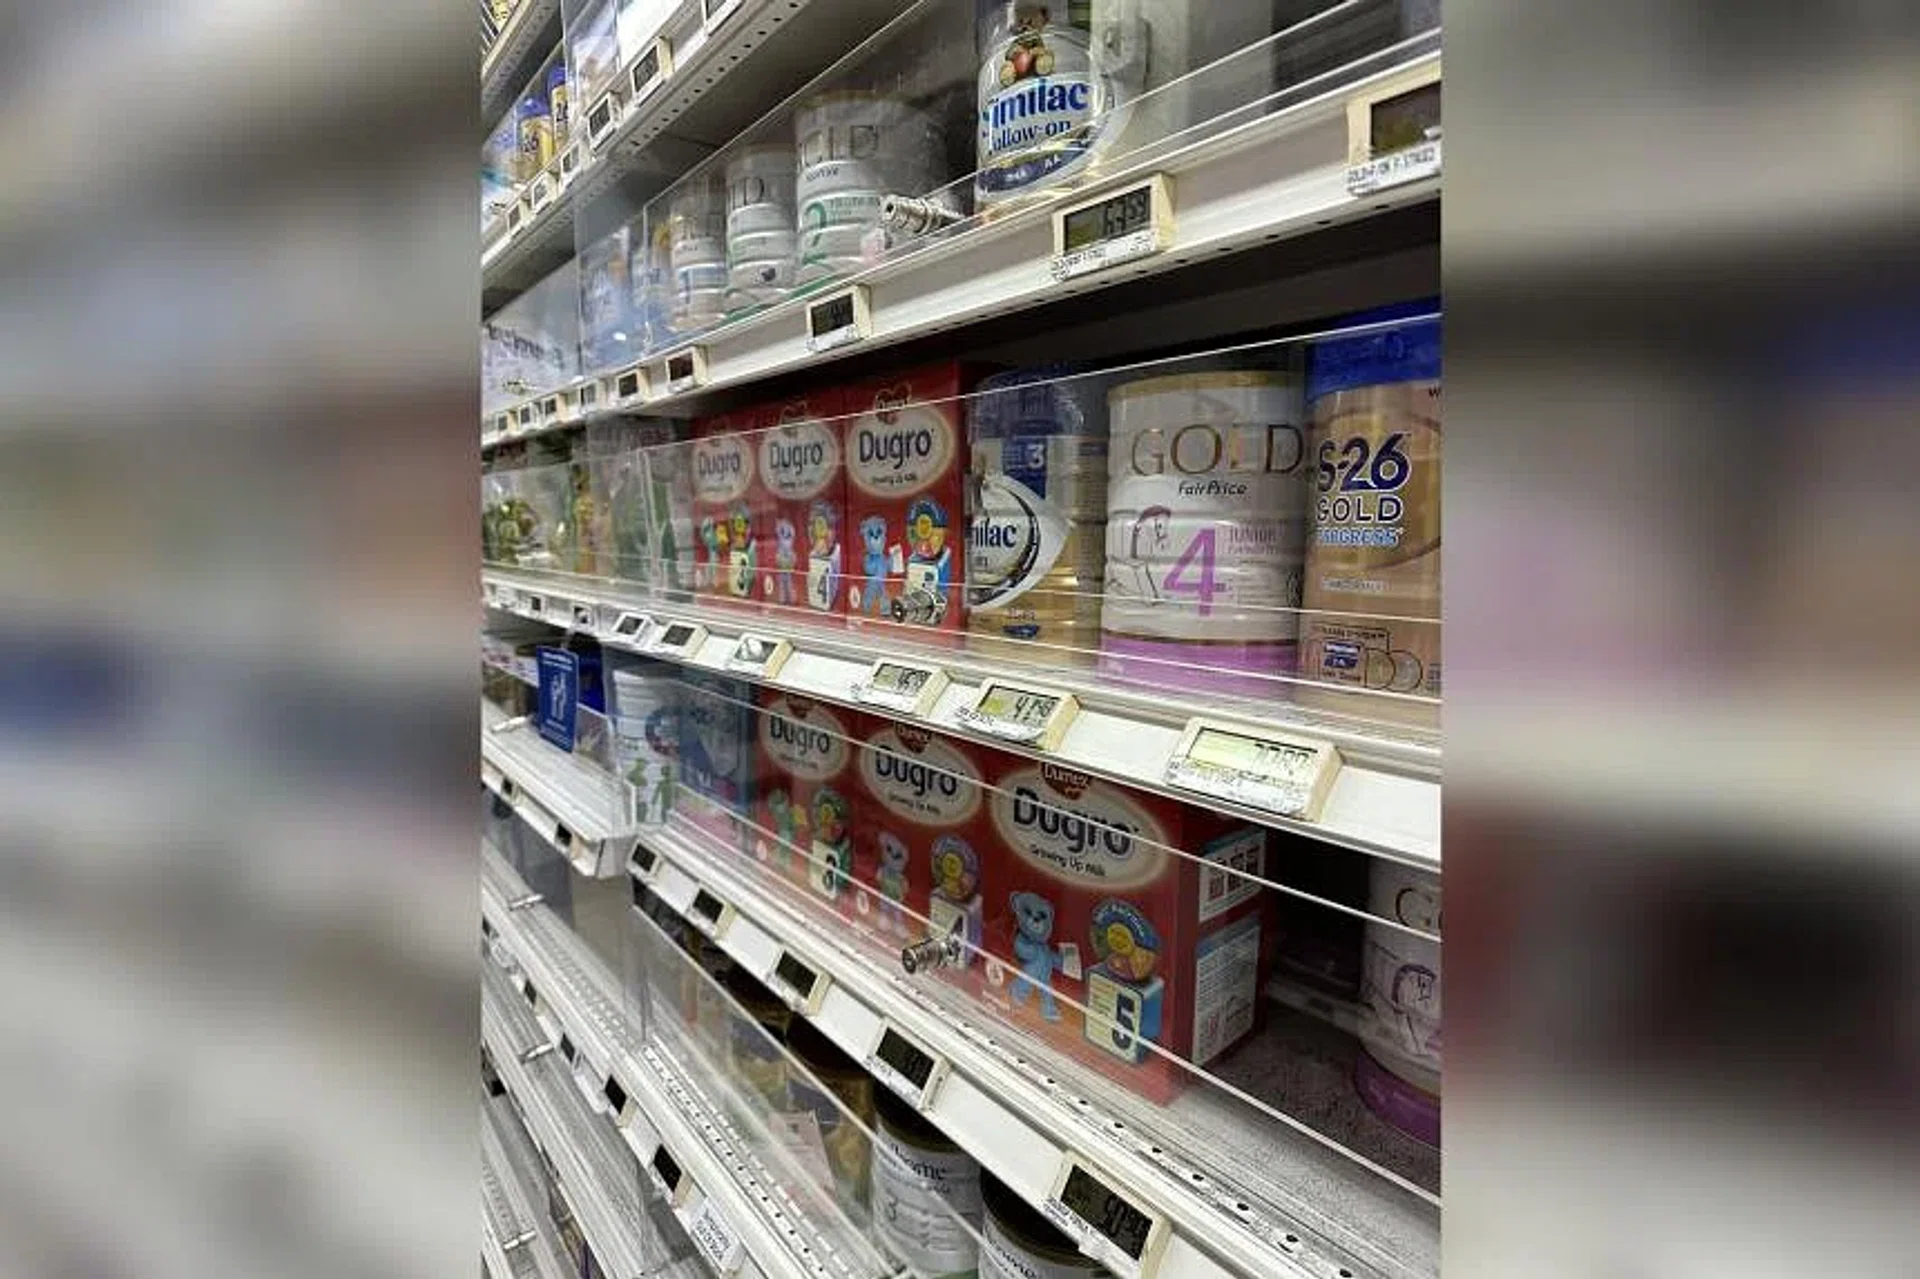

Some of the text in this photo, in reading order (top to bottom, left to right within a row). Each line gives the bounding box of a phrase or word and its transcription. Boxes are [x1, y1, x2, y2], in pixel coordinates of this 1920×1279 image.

[700, 446, 742, 479] Dugro
[769, 441, 823, 477] Dugro
[858, 428, 934, 472] Dugro
[1026, 443, 1044, 469] 3
[1131, 424, 1304, 476] GOLD
[1317, 433, 1411, 493] S-26
[1178, 479, 1247, 497] FairPrice
[1316, 497, 1403, 522] GOLD
[1163, 529, 1226, 616] 4
[769, 714, 831, 755] Dugro
[875, 746, 959, 797] Dugro
[1013, 787, 1132, 855] Dugro
[1111, 992, 1136, 1051] 5
